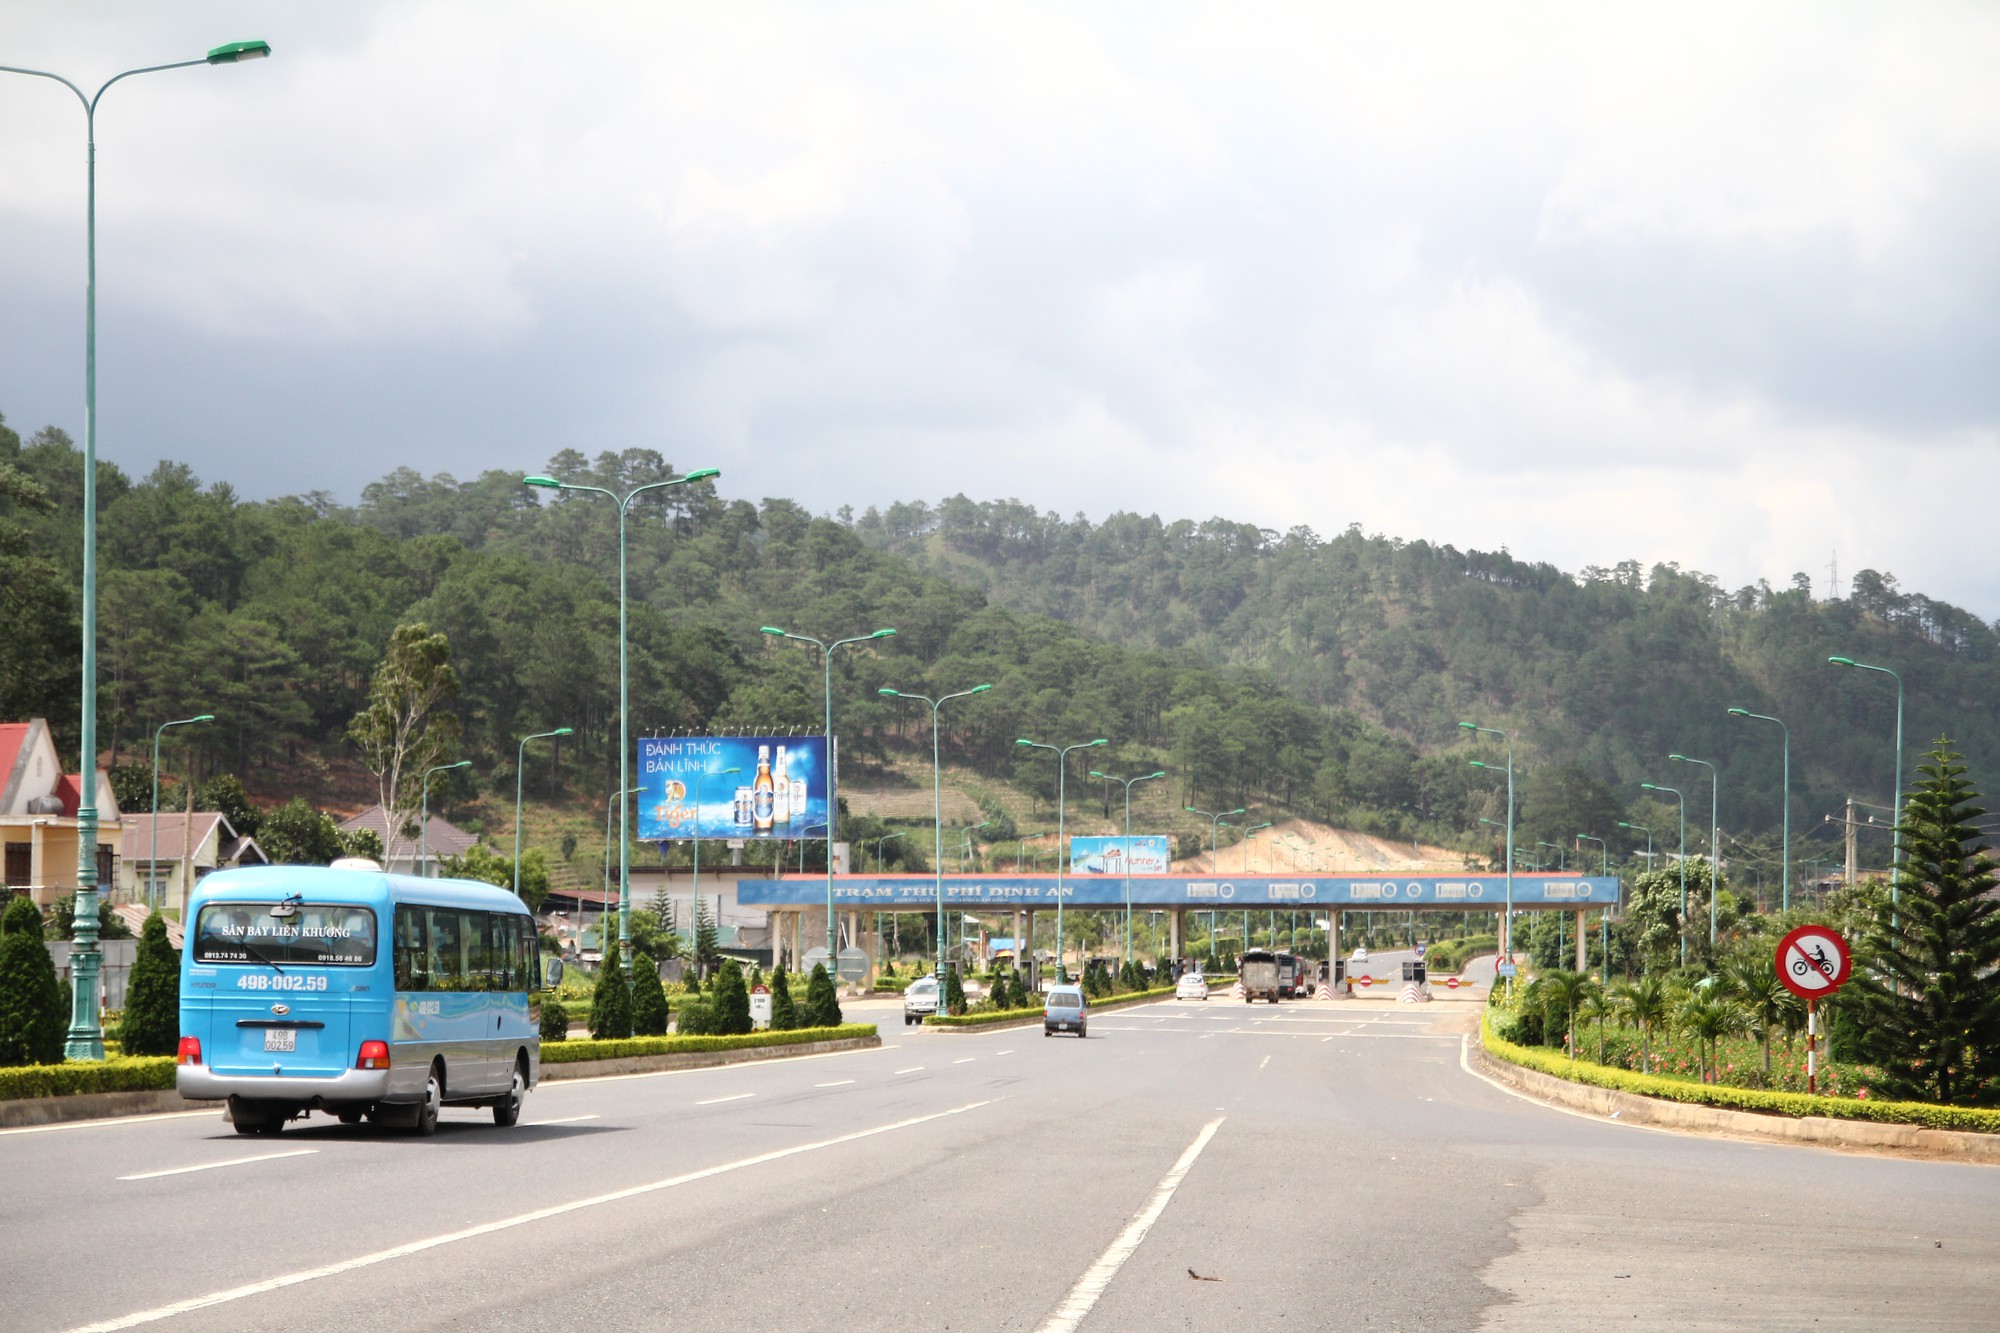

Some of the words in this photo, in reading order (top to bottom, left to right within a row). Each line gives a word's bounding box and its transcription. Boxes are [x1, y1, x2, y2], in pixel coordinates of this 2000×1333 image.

[654, 804, 698, 828] Tiger
[833, 887, 893, 898] TRẠM
[899, 887, 939, 897] THU
[947, 885, 982, 896] PHÍ
[989, 887, 1040, 898] ĐỊNH
[1046, 887, 1074, 897] AN
[222, 925, 245, 936] SÂN
[247, 926, 269, 937] BAY
[272, 925, 299, 937] LIÊN
[302, 925, 350, 938] KHƯƠNG
[273, 1031, 288, 1040] 49B
